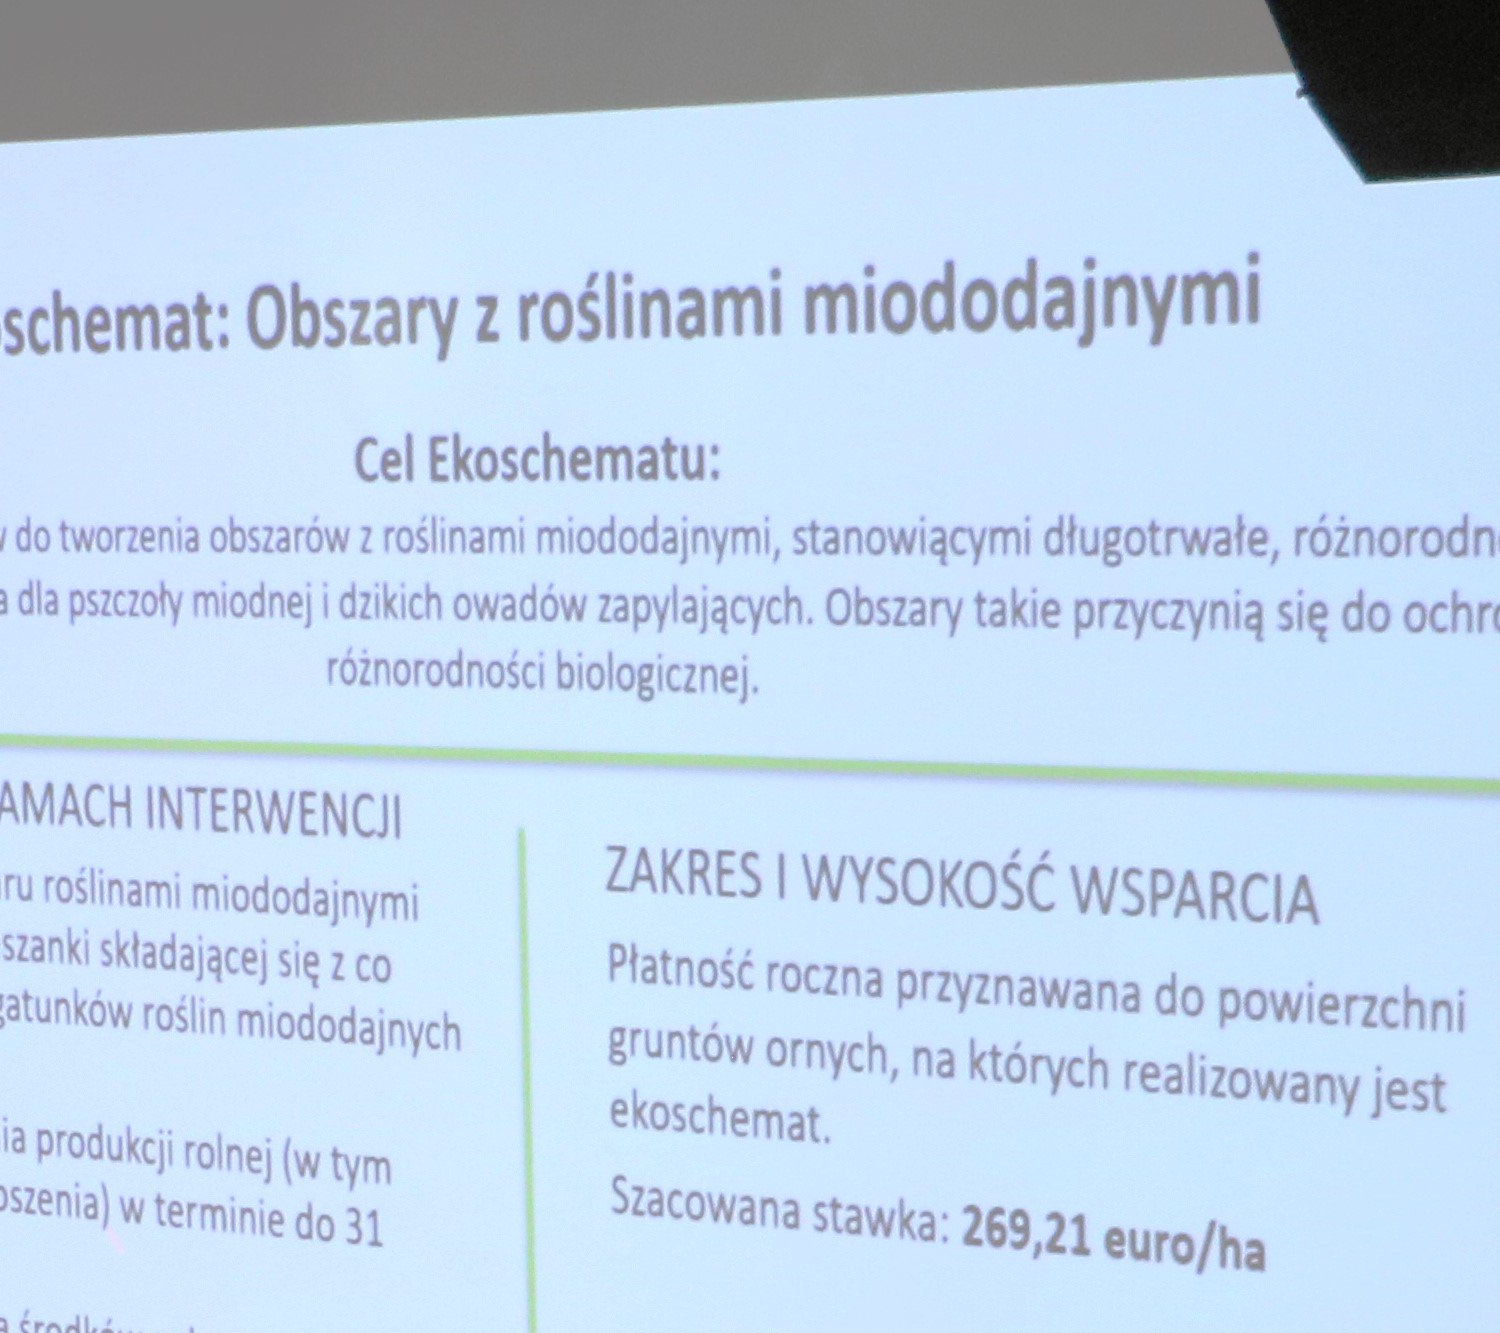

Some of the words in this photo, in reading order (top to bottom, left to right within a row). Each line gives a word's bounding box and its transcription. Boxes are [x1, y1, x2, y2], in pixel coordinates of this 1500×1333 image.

[247, 280, 459, 362] Obszary
[476, 294, 500, 343] z
[519, 267, 782, 342] roślinami
[805, 250, 1260, 348] miododajnymi
[355, 432, 414, 483] Cel
[429, 431, 719, 482] Ekoschematu:
[15, 516, 51, 553] do
[59, 516, 199, 553] tworzenia
[210, 515, 350, 553] obszarów
[383, 515, 525, 554] roślinami
[537, 514, 780, 565] miododajnymi,
[793, 514, 1031, 566] stanowiącymi
[1044, 513, 1280, 567] długotrwałe,
[18, 579, 59, 616] dla
[69, 580, 183, 626] pszczoły
[193, 580, 312, 628] miodnej
[339, 581, 442, 620] dzikich
[453, 582, 587, 622] owadów
[598, 584, 813, 635] zapylających.
[825, 585, 963, 637] Obszary
[973, 586, 1061, 628] takie
[1074, 588, 1264, 641] przyczynią
[1277, 589, 1329, 643] się
[1342, 588, 1391, 633] do
[328, 646, 545, 689] różnorodności
[557, 649, 758, 704] biologicznej.
[147, 784, 401, 839] INTERWENCJI
[44, 866, 180, 908] roślinami
[192, 874, 418, 928] miododajnymi
[606, 844, 762, 898] ZAKRES
[778, 852, 785, 899] I
[802, 848, 1055, 912] WYSOKOŚĆ
[1070, 864, 1320, 925] WSPARCIA
[100, 929, 267, 985] składającej
[278, 940, 320, 989] się
[356, 953, 392, 983] co
[609, 941, 754, 990] Płatność
[767, 961, 883, 997] roczna
[897, 968, 1141, 1013] przyznawana
[1155, 971, 1204, 1017] do
[1219, 980, 1465, 1033] powierzchni
[143, 994, 225, 1034] roślin
[237, 1001, 461, 1057] miododajnych
[608, 1021, 754, 1066] gruntów
[766, 1031, 898, 1082] ornych,
[913, 1046, 955, 1079] na
[969, 1037, 1109, 1095] których
[1124, 1051, 1360, 1117] realizowany
[1370, 1065, 1447, 1119] jest
[610, 1088, 830, 1144] ekoschemat.
[37, 1122, 173, 1175] produkcji
[185, 1132, 272, 1184] rolnej
[283, 1136, 321, 1185] (w
[330, 1146, 391, 1191] tym
[154, 1192, 285, 1238] terminie
[295, 1201, 335, 1242] do
[346, 1206, 383, 1247] 31
[612, 1173, 800, 1229] Szacowana
[814, 1196, 948, 1243] stawka:
[963, 1204, 1091, 1259] 269,21
[1104, 1219, 1266, 1275] euro/ha
